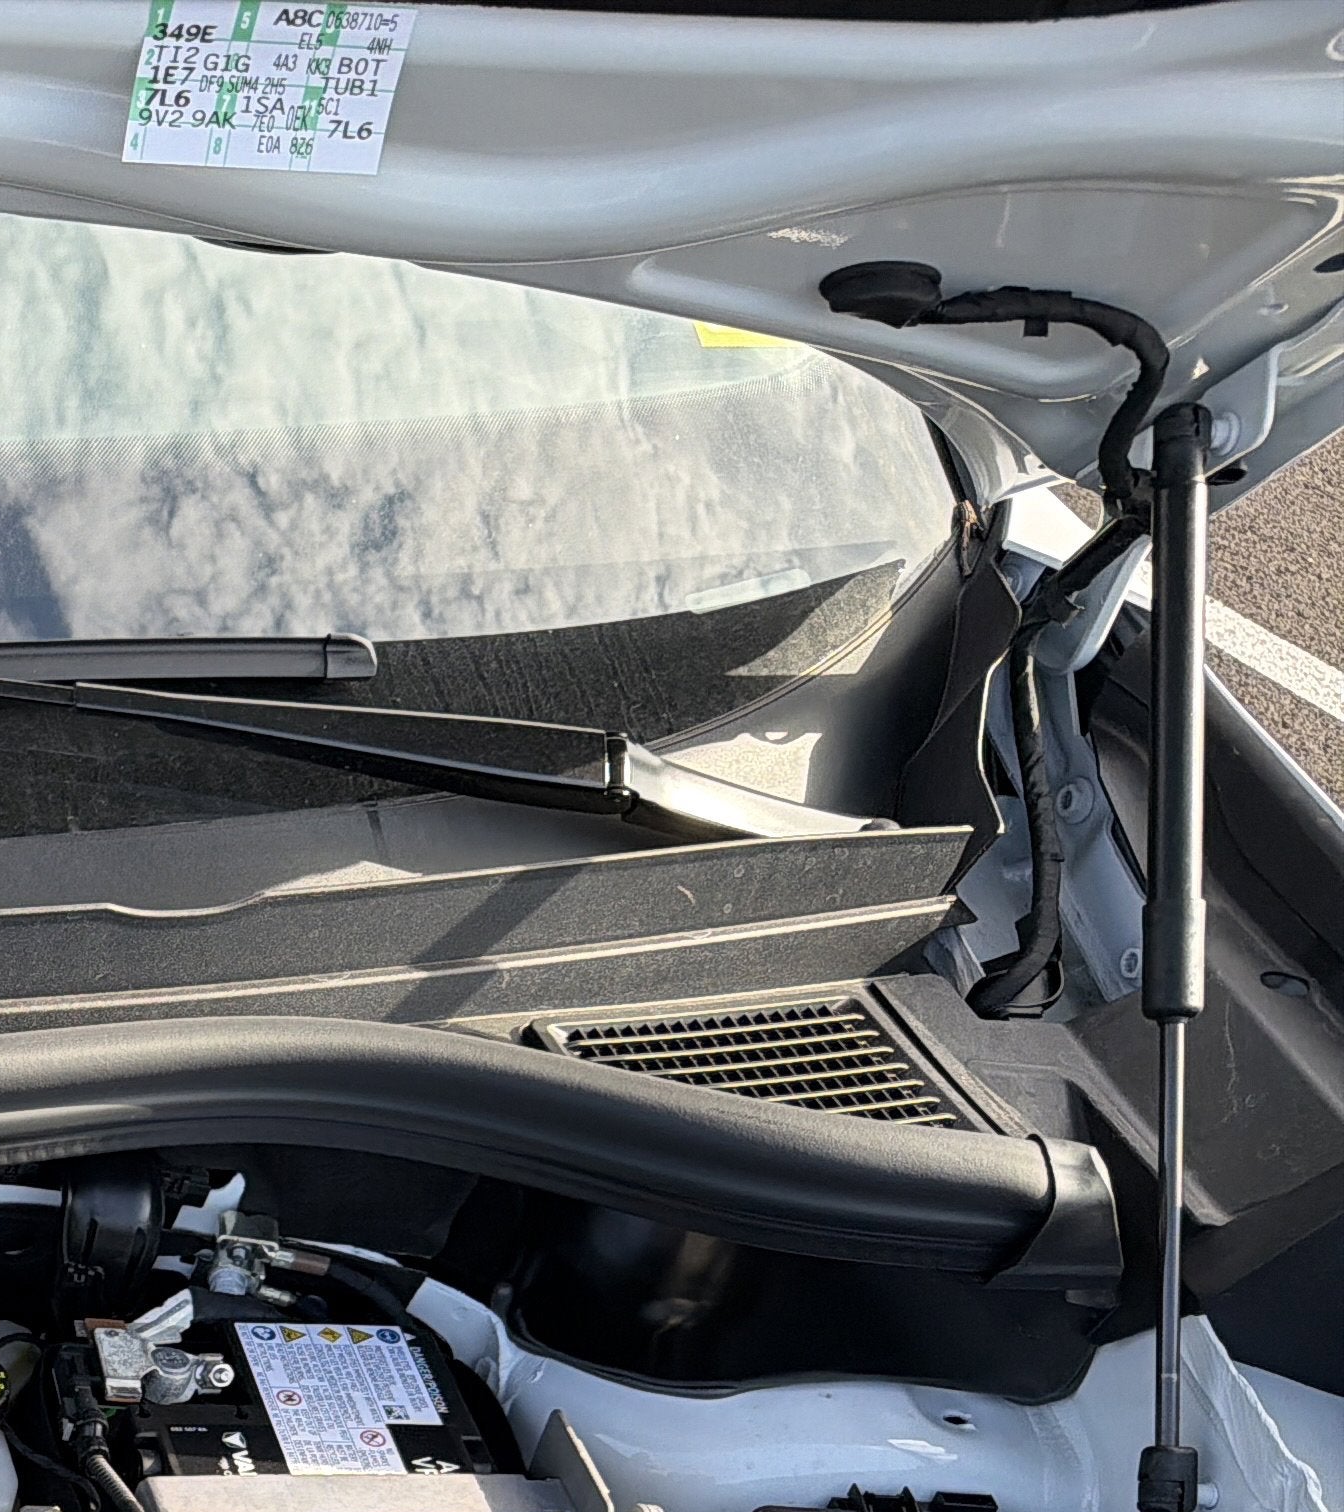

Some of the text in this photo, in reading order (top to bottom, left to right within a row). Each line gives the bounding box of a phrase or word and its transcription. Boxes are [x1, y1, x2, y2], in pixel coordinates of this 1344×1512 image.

[241, 11, 251, 29] 5
[153, 23, 218, 43] 349E
[298, 32, 393, 55] EL5 4NH
[204, 53, 252, 73] G1G
[273, 53, 298, 72] 4A3
[306, 58, 332, 76] KK3
[147, 65, 196, 85] 1E7
[199, 74, 224, 93] DF9
[262, 77, 287, 96] 2H5
[144, 88, 192, 107] 7L6
[241, 96, 285, 115] 1SA
[139, 107, 183, 128] 9V2
[192, 109, 236, 129] 9AK
[328, 119, 373, 140] 7L6
[130, 133, 139, 150] 4
[213, 137, 222, 155] 8
[410, 1346, 448, 1413] DANGER/POISON
